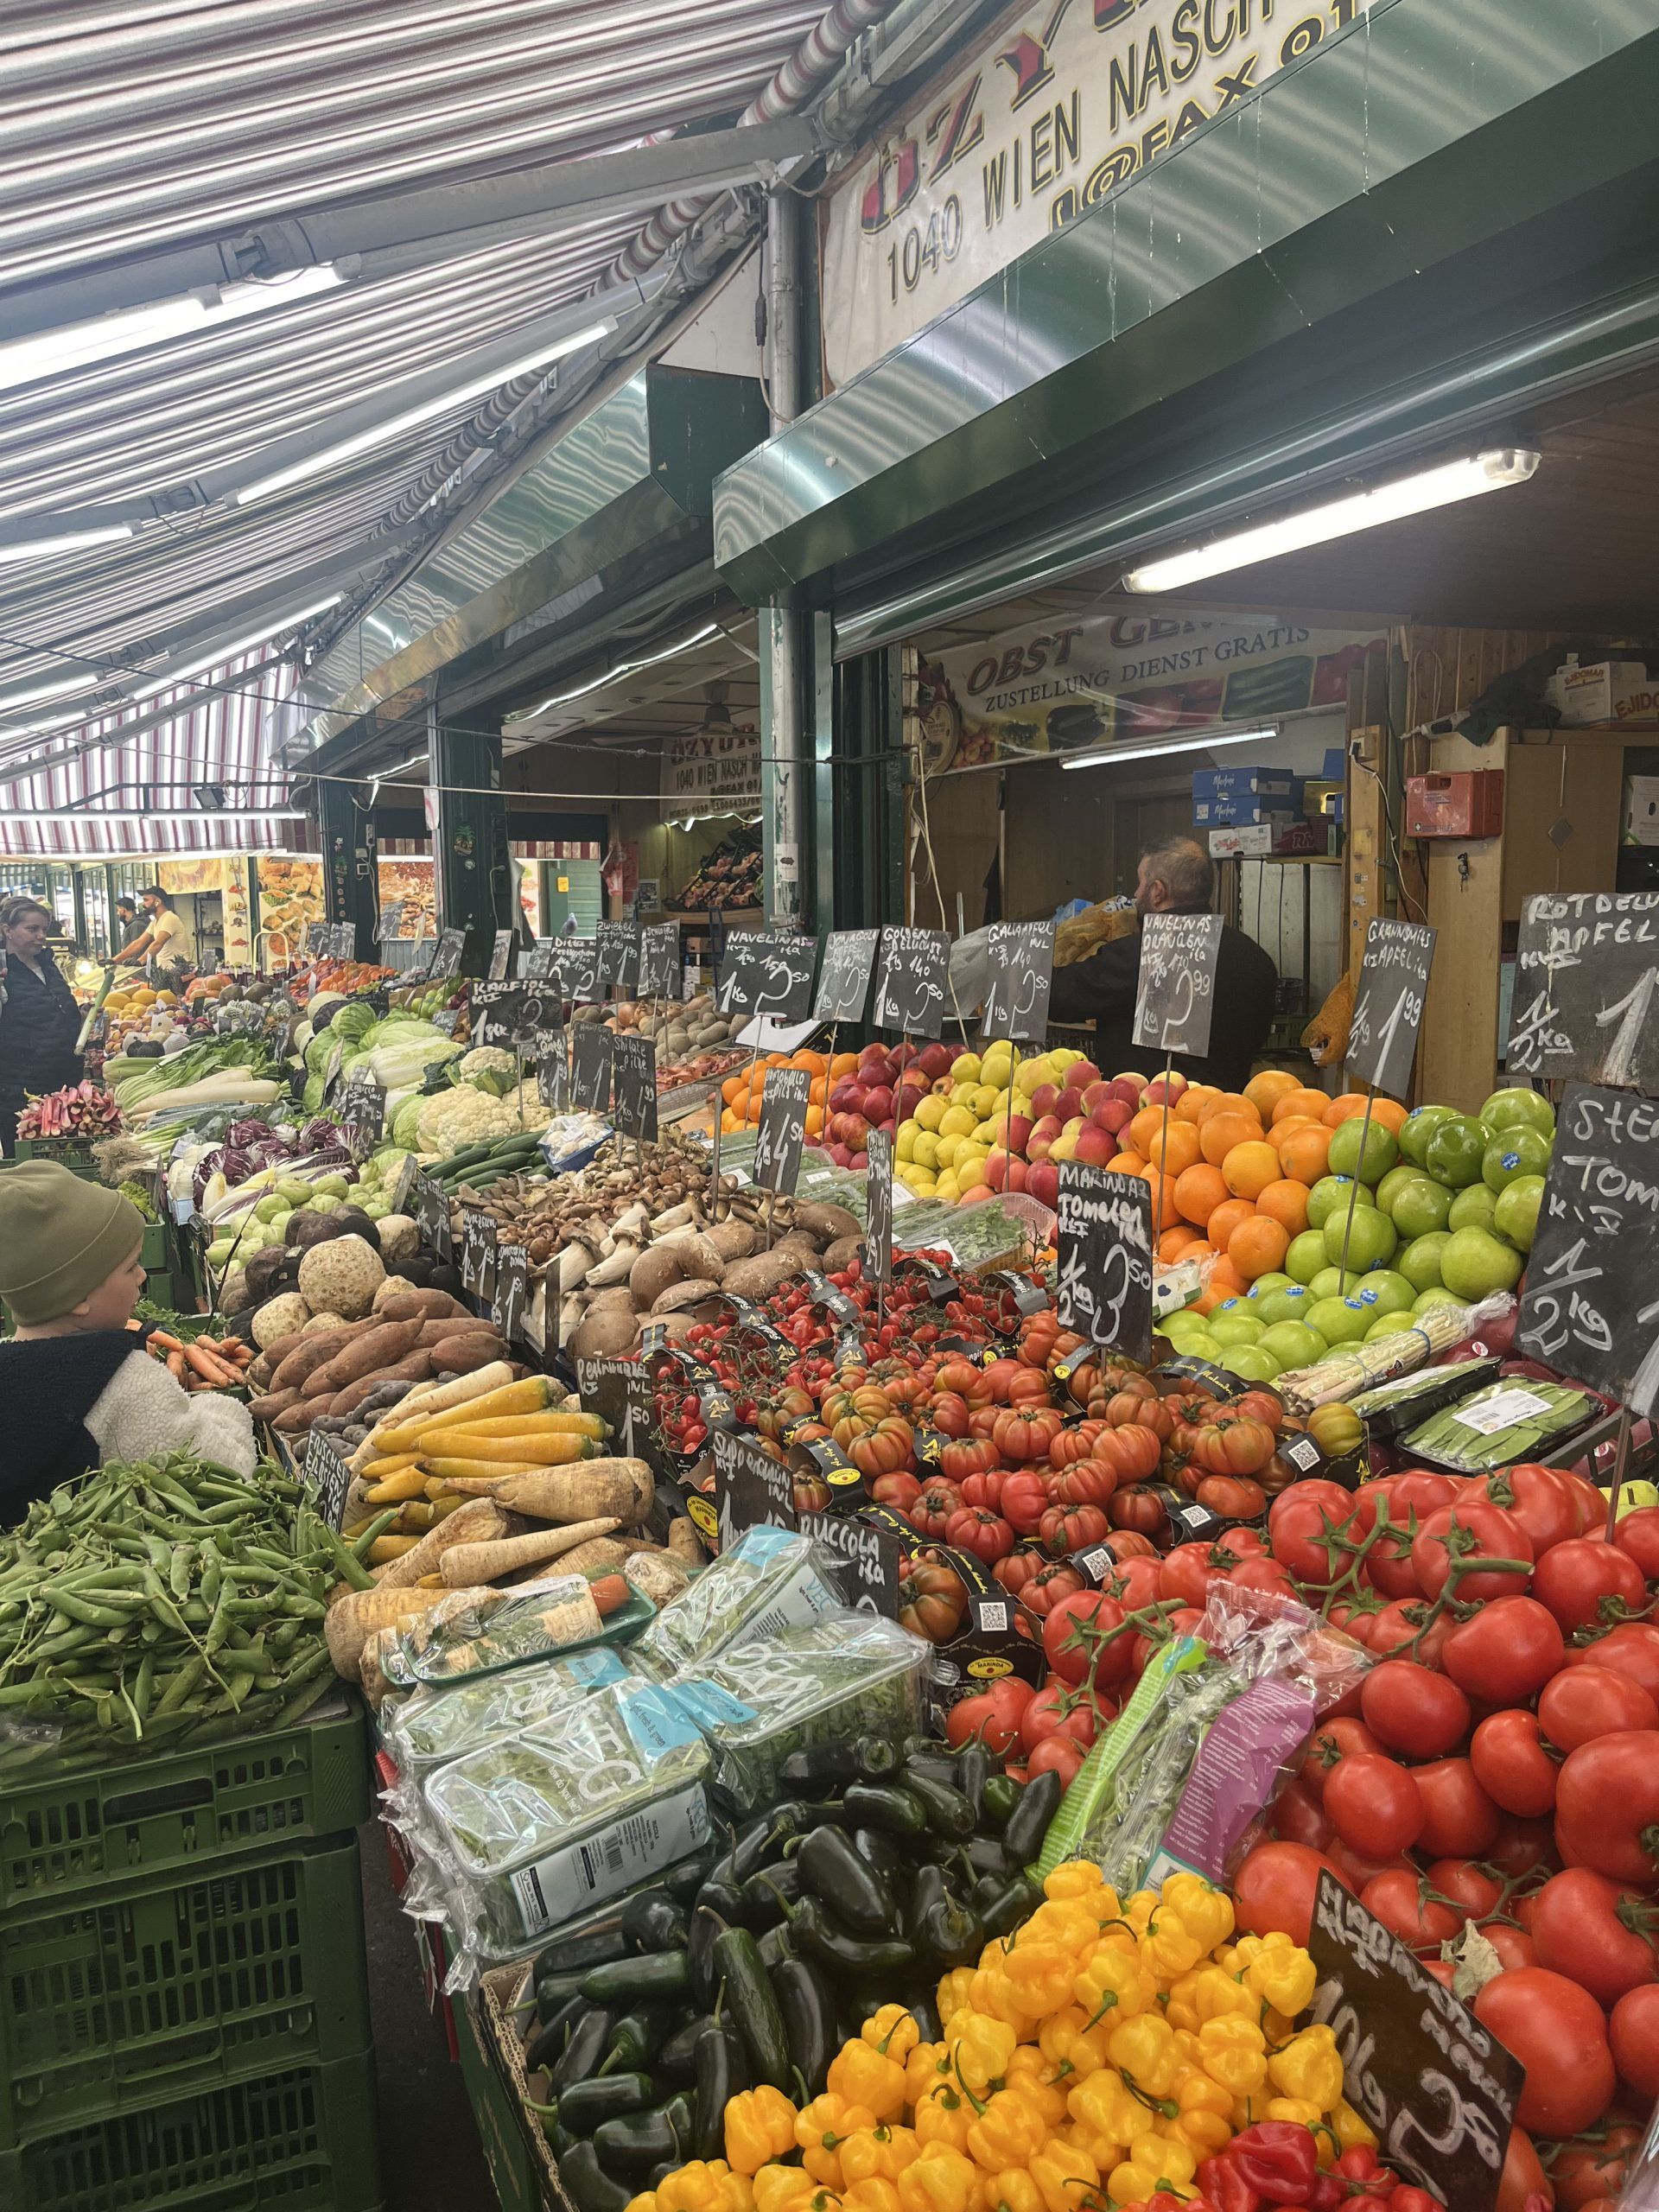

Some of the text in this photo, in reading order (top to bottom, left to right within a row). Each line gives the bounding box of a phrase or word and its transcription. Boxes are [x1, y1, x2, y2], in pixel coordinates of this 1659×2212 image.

[887, 193, 963, 302] 1040
[983, 88, 1080, 230] WIEN
[967, 627, 1083, 696] OBST
[986, 671, 1110, 714] ZUSTELLUNG
[1122, 646, 1209, 683] DIENST
[1215, 626, 1310, 663] GRATIS
[1144, 915, 1212, 932] NAVELINAS
[1528, 894, 1593, 925] ROT
[728, 931, 807, 947] NAVELINAS
[884, 927, 931, 942] GOLDEN
[1551, 918, 1657, 953] APFEL
[474, 980, 550, 995] KARFIOL
[800, 1515, 880, 1562] RUCCOLA
